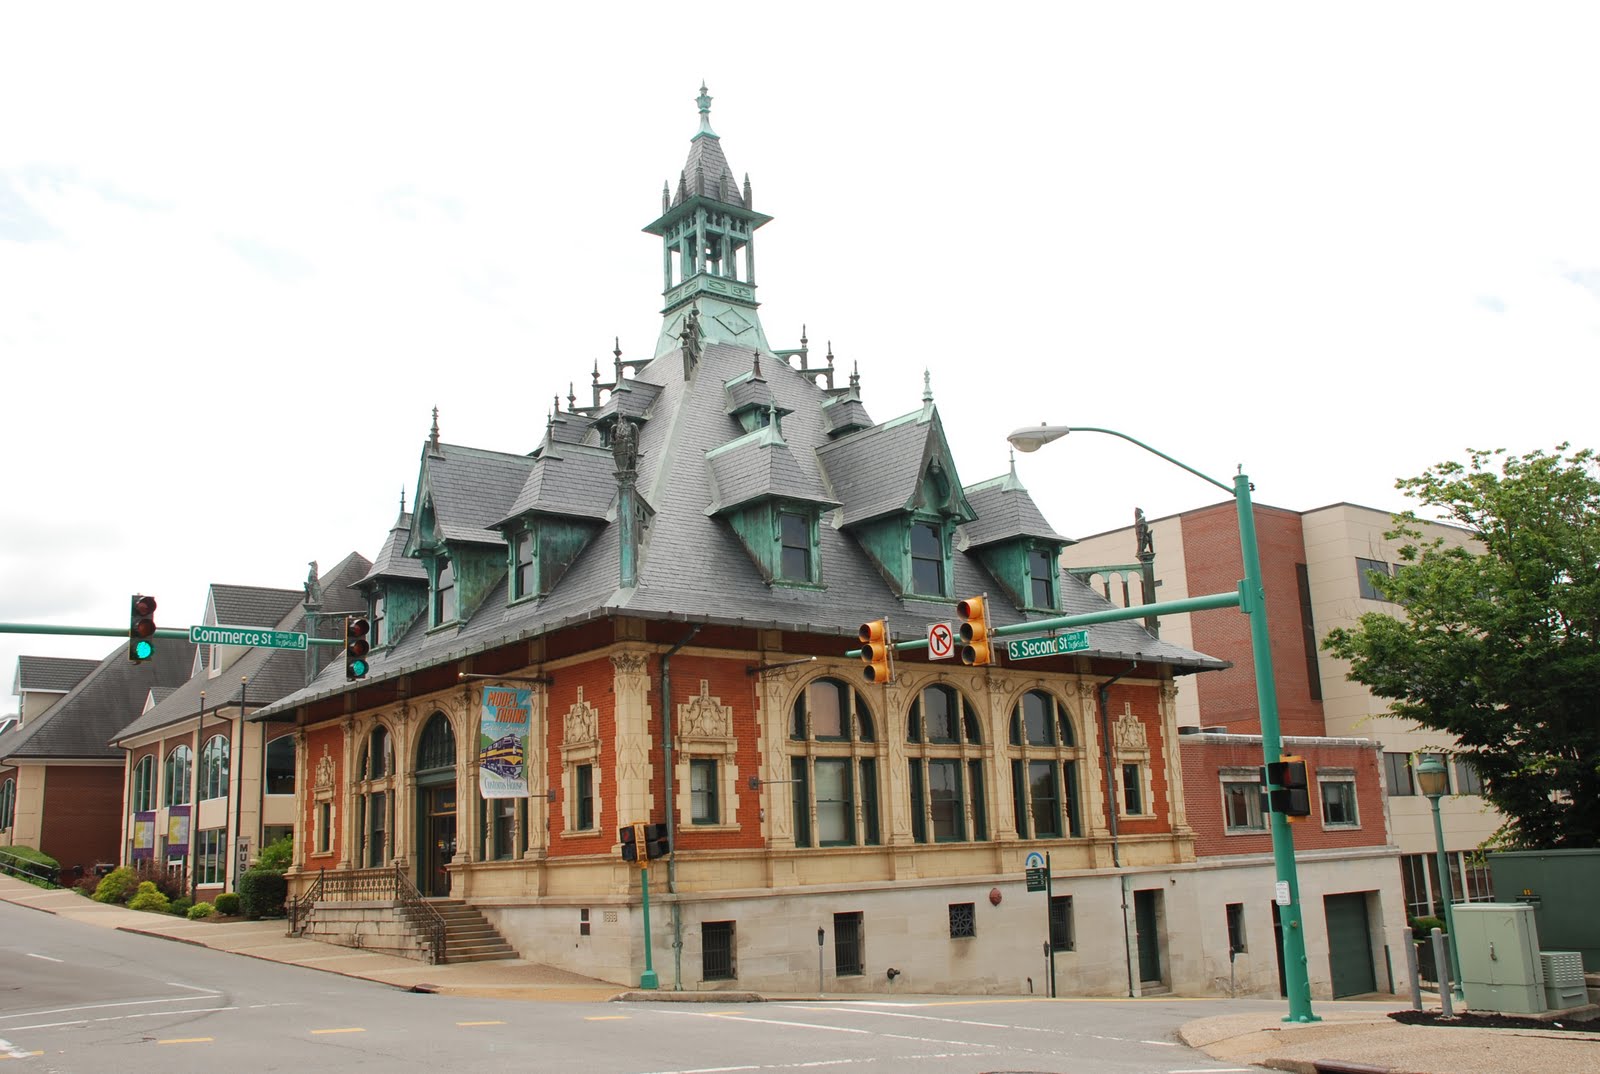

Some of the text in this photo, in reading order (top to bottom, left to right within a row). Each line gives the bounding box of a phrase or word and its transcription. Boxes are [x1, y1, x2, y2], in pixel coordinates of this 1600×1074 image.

[192, 626, 272, 645] Commerce St
[1011, 637, 1068, 657] S. Second St
[487, 691, 519, 707] MODEL
[495, 708, 528, 724] TRAINS
